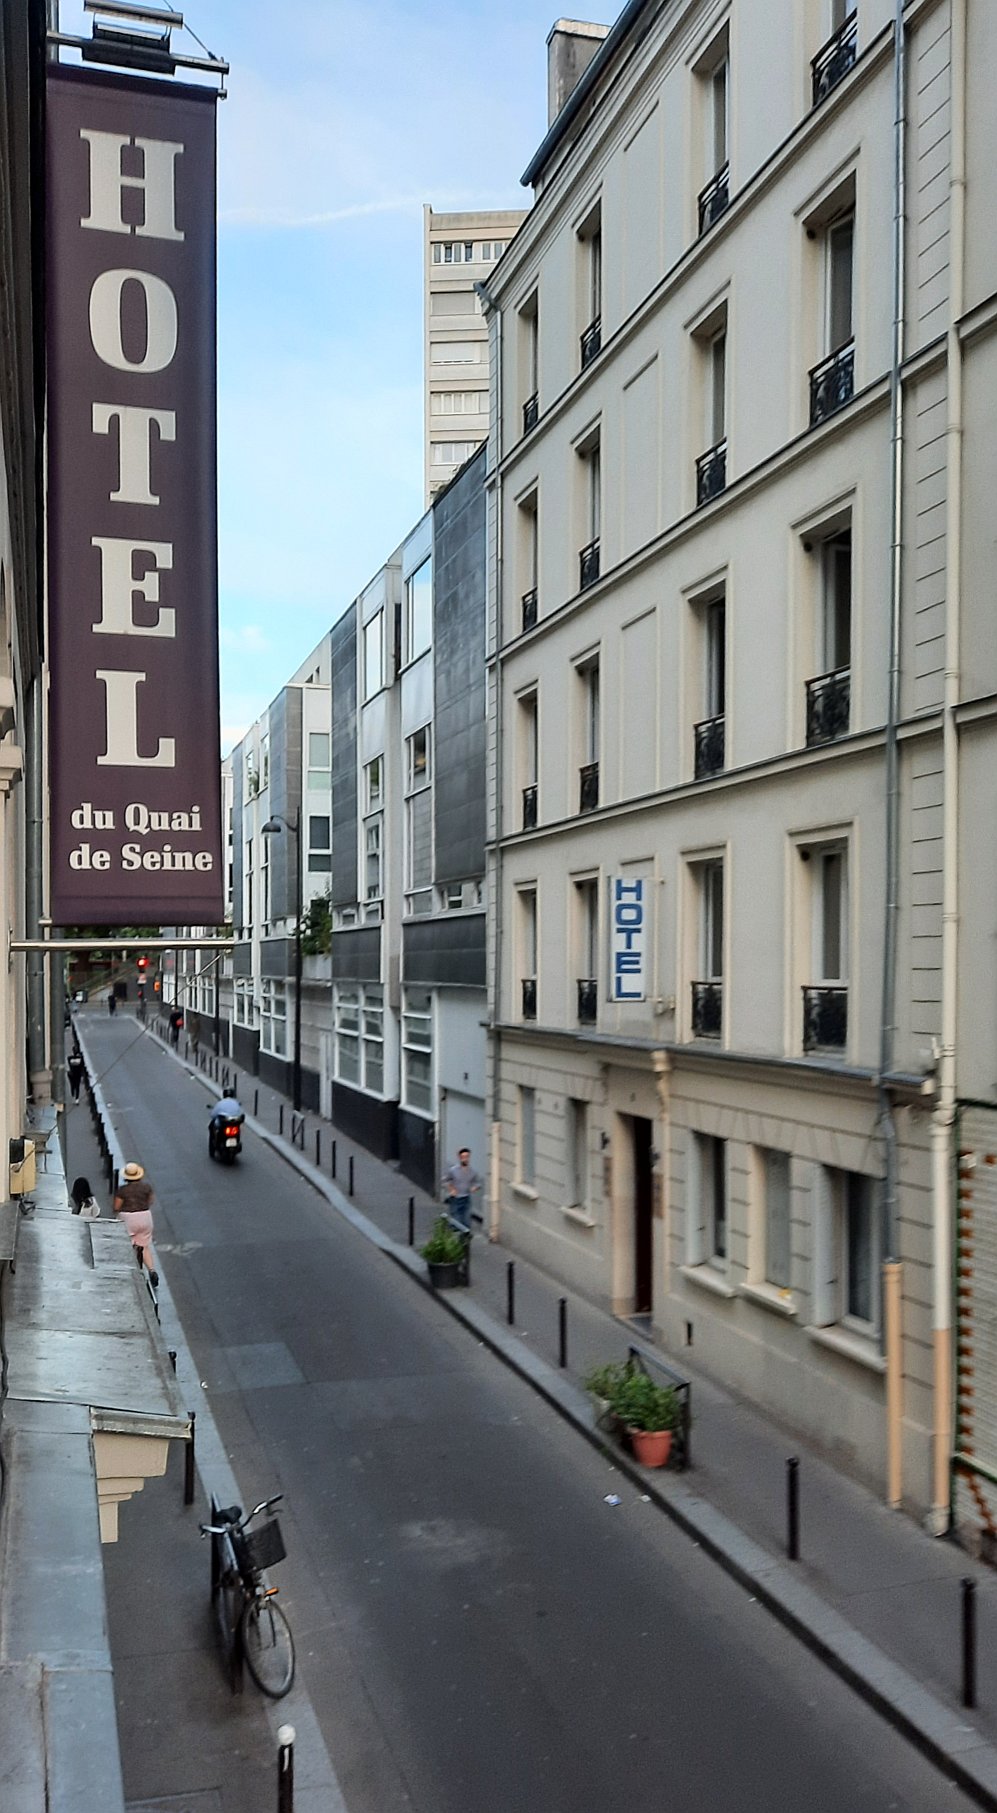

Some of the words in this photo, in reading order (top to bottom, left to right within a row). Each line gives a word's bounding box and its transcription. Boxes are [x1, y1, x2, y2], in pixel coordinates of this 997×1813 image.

[79, 128, 185, 769] HOTEL
[69, 843, 112, 871] de
[121, 843, 213, 872] Seine
[71, 802, 116, 831] du
[125, 803, 203, 836] Quai
[615, 878, 644, 999] HOTEL
